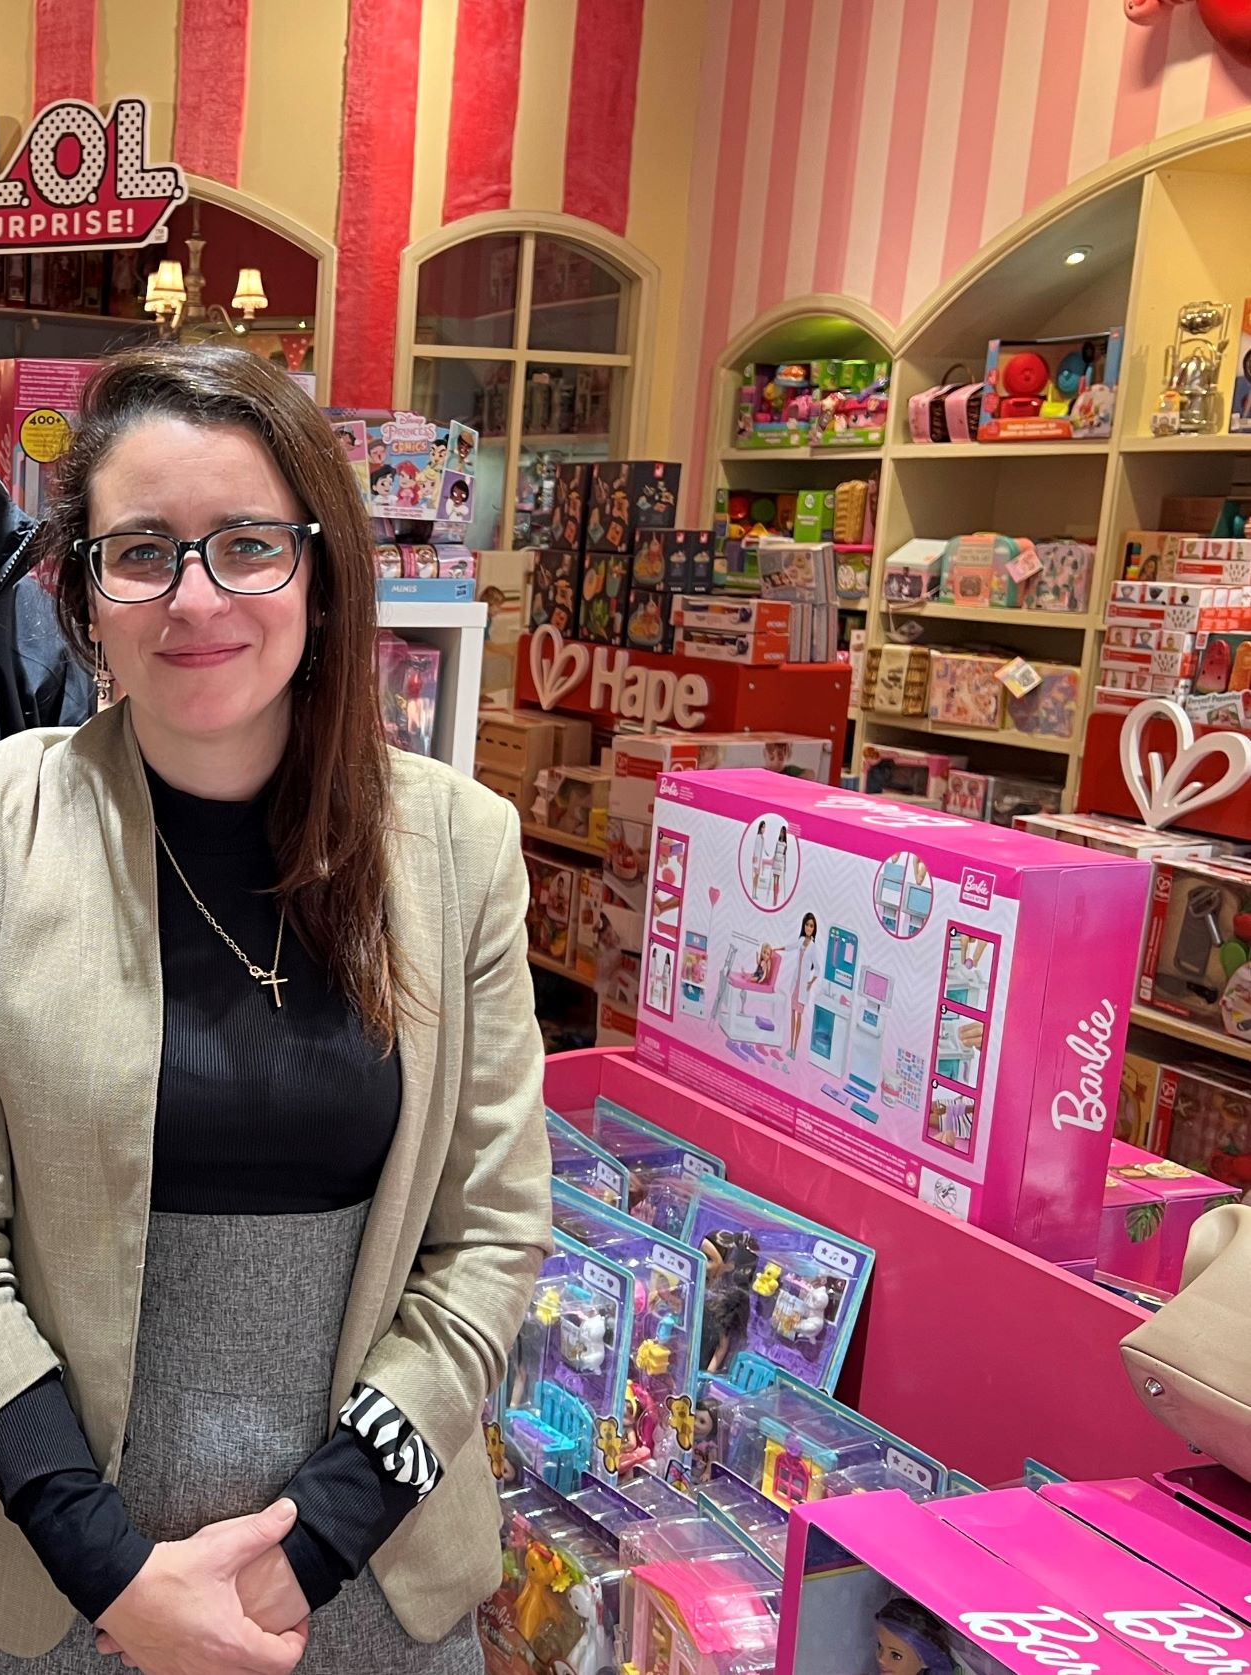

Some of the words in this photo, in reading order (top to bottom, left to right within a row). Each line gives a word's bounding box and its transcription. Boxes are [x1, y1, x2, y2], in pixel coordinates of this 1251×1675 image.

[29, 415, 61, 426] 400+
[391, 585, 418, 593] MINIS
[590, 647, 709, 734] Hape
[659, 777, 679, 797] Barbie
[964, 875, 989, 895] Barbie
[951, 927, 955, 936] 4
[942, 1004, 947, 1014] 5
[1051, 998, 1115, 1132] Barbie
[932, 1079, 938, 1088] 6
